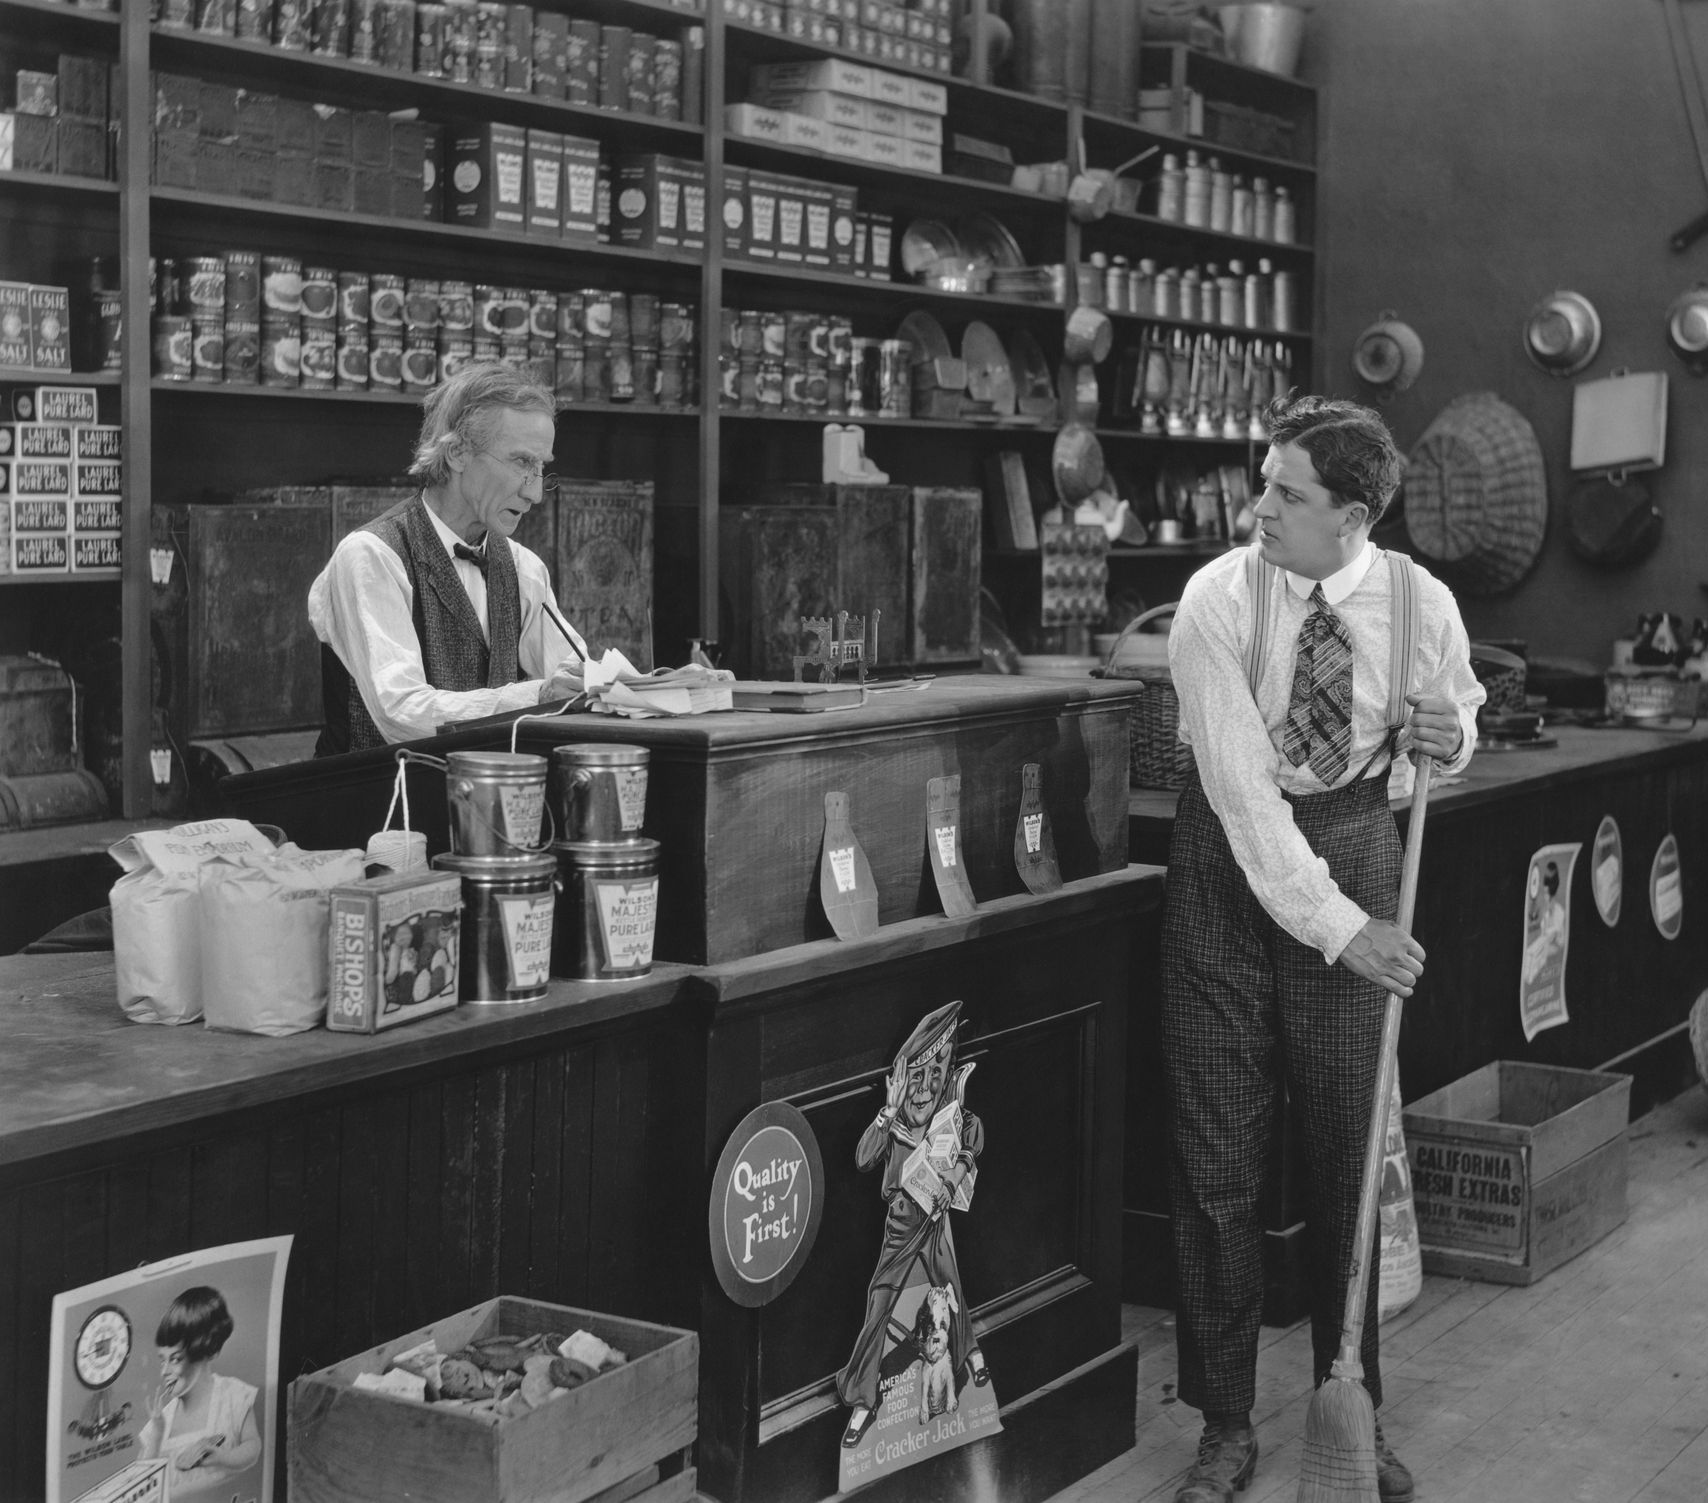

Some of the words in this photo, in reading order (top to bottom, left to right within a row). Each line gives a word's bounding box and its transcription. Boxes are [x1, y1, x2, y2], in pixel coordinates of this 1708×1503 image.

[32, 291, 66, 310] LESLIE
[36, 346, 66, 363] SALT
[49, 392, 88, 407] LAUREL
[44, 403, 69, 418] PURE
[69, 404, 94, 419] LARD
[27, 427, 65, 442] LAUREL
[23, 438, 46, 454] PURE
[47, 440, 71, 455] LARD
[24, 463, 62, 478] LAUREL
[18, 475, 42, 491] PURE
[44, 475, 68, 491] LARD
[22, 502, 60, 515] LAUREL
[81, 502, 118, 516] LAUREL
[17, 512, 41, 528] PURE
[43, 512, 66, 528] LARD
[76, 513, 99, 528] PURE
[23, 539, 61, 553] LAUREL
[81, 539, 119, 554] LAUREL
[18, 550, 42, 565] PURE
[43, 550, 66, 565] LARD
[76, 550, 100, 566] PURE
[609, 923, 639, 937] PURE
[514, 939, 541, 955] PURE
[343, 913, 366, 1017] BISHOP'S
[1415, 1146, 1512, 1181] CALIFORNIA
[733, 1157, 803, 1202] Quality
[1458, 1177, 1522, 1207] EXTRAS
[761, 1191, 776, 1214] is
[878, 1367, 917, 1393] AMERICA'S
[882, 1382, 915, 1404] FAMOUS
[887, 1397, 909, 1414] FOOD
[877, 1405, 920, 1431] CONFECTION
[875, 1429, 931, 1465] Cracker
[931, 1413, 967, 1444] Jack
